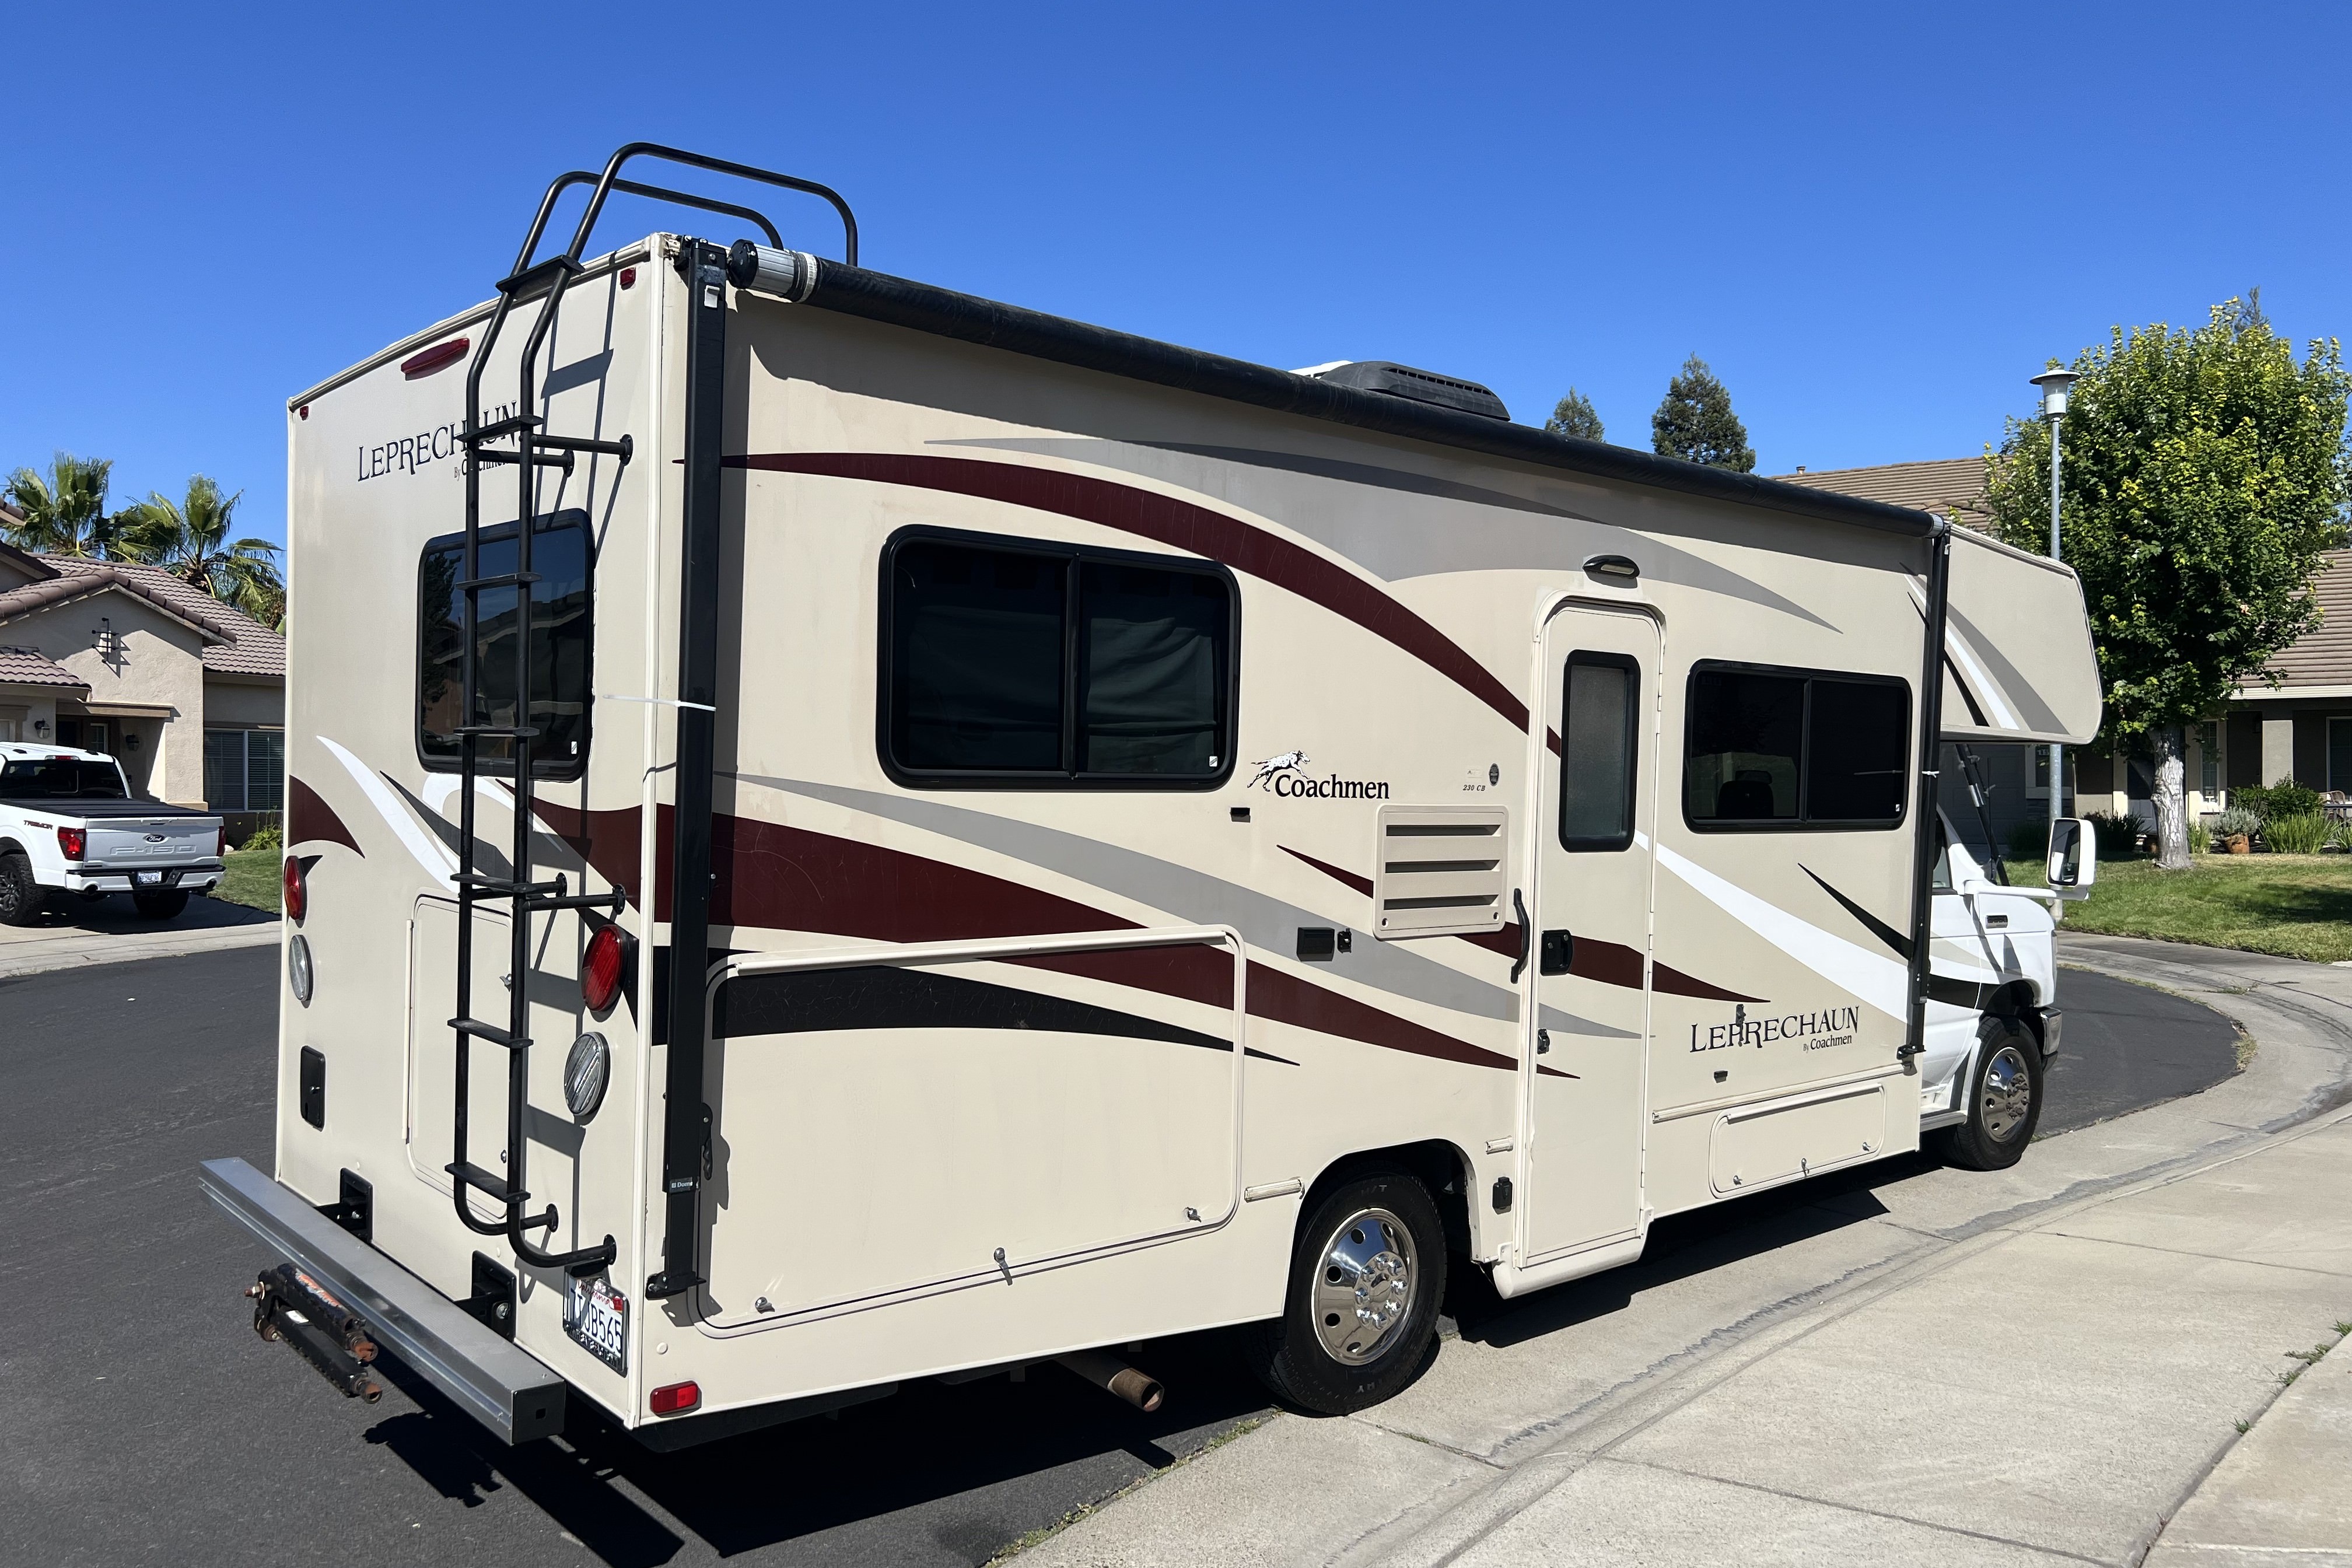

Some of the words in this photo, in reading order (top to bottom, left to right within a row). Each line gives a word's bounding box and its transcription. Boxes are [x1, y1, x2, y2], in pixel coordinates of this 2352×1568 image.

[358, 400, 517, 482] LEPRECHUN
[454, 467, 461, 481] By
[1275, 774, 1390, 799] Coachmen
[110, 845, 197, 855] F-150
[1803, 1043, 1810, 1054] By
[1810, 1035, 1852, 1051] Coachmen
[570, 1287, 622, 1354] 7TJB565
